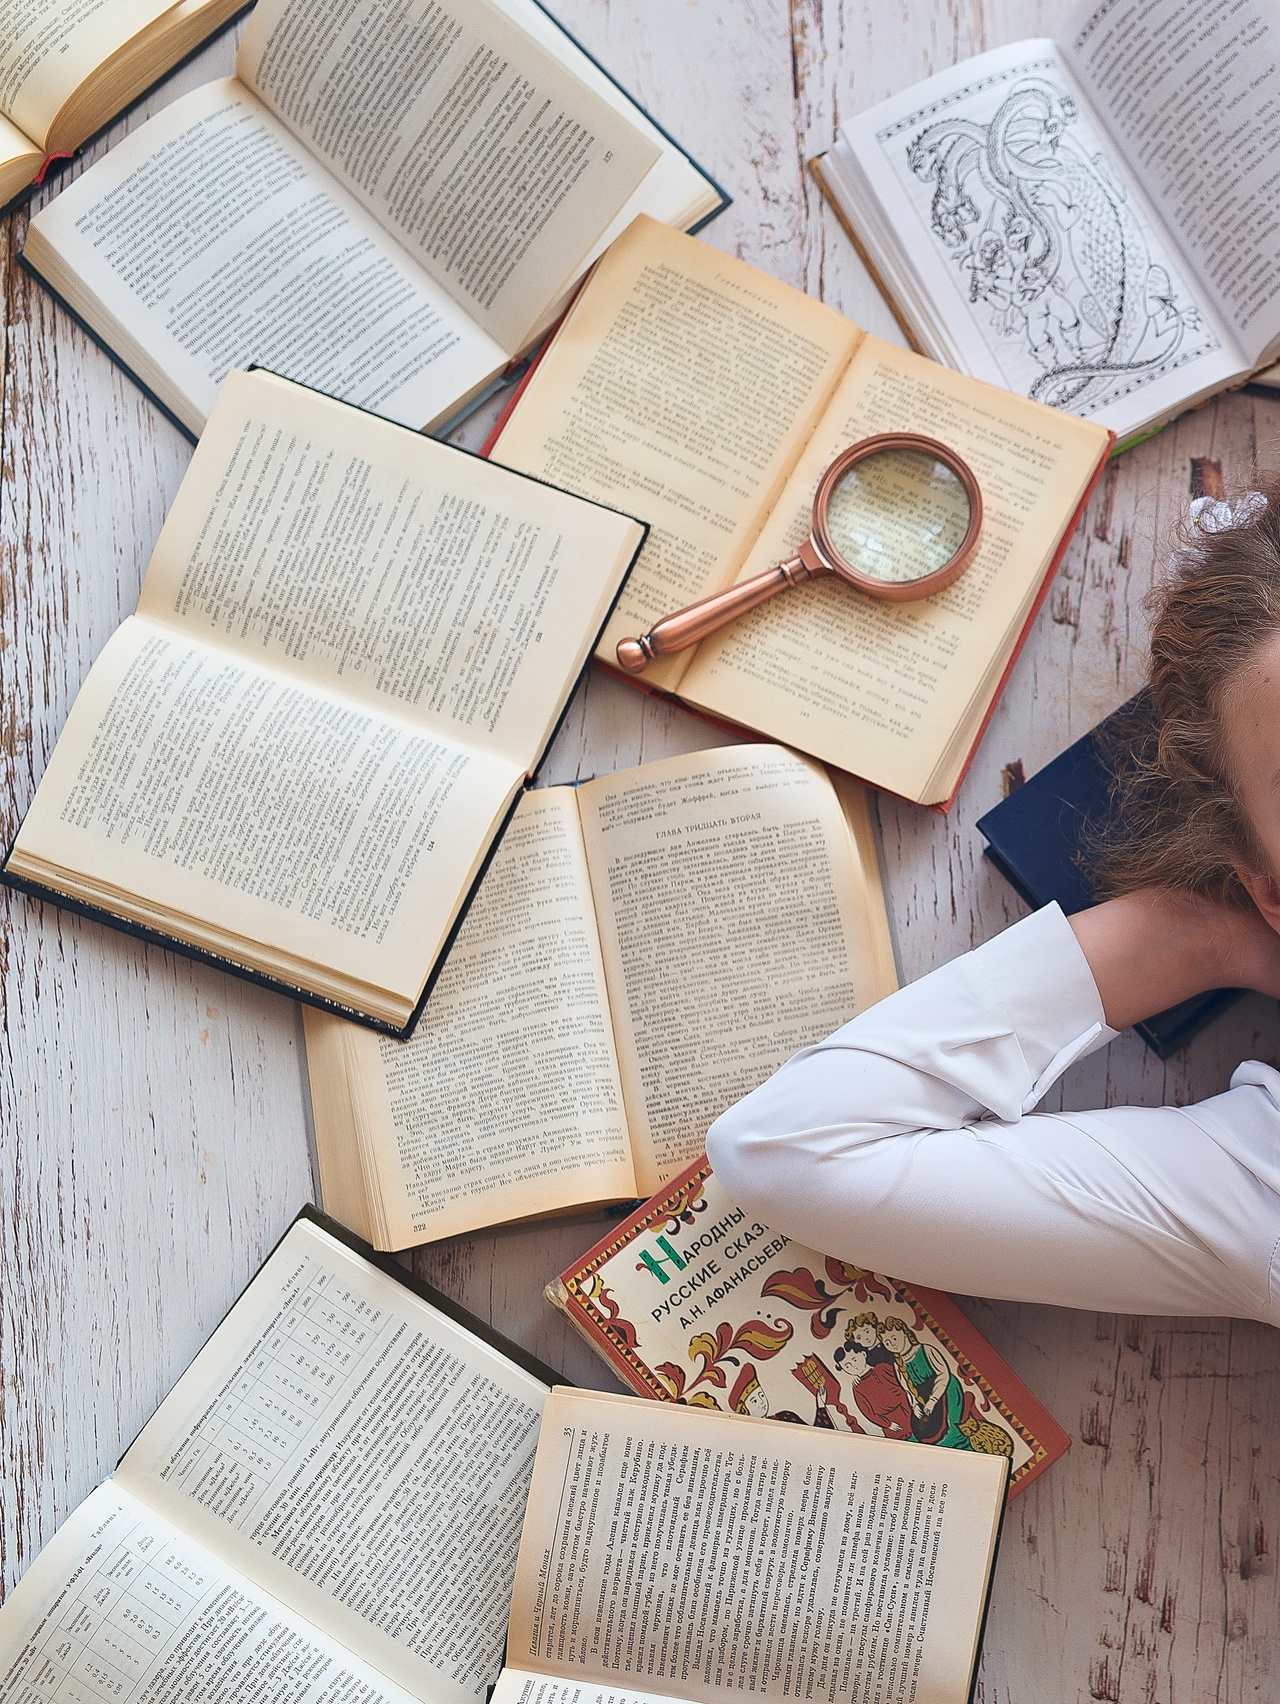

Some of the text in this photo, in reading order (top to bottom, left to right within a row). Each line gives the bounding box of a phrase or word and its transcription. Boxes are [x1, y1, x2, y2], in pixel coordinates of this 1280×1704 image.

[655, 812, 762, 839] ГЛАВА ТРИДЦАТЬ ВТОРАЯ
[426, 840, 435, 852] 124
[363, 903, 380, 932] мыслях.
[481, 1142, 505, 1154] страхе
[505, 1134, 540, 1147] подумала
[542, 1125, 580, 1138] Анжелика.
[401, 1144, 475, 1170] ла добежать до таза.
[417, 1193, 430, 1202] Но
[430, 1184, 462, 1198] внезапно
[462, 1179, 483, 1189] страх
[483, 1172, 506, 1184] сошел
[523, 1163, 541, 1173] лица
[548, 1158, 562, 1166] оно
[412, 1222, 427, 1233] 322
[638, 1206, 749, 1285] НАРОДНЫ
[281, 1263, 305, 1292] Таблица
[650, 1222, 770, 1323] РУССКИЕ СКАЗ
[679, 1233, 793, 1330] А.Н. АФАНАСЬЕВА
[248, 1520, 265, 1541] торце
[262, 1488, 290, 1522] световода,
[286, 1462, 307, 1489] равной
[307, 1443, 323, 1459] мВт,
[319, 1398, 353, 1444] внутривенное
[350, 1365, 377, 1400] облучение
[374, 1321, 408, 1367] осуществляют
[562, 1427, 572, 1437] 35
[576, 1438, 586, 1460] лица
[623, 1436, 633, 1458] юнее
[177, 1457, 195, 1477] Частота,
[192, 1448, 201, 1457] Гц
[572, 1461, 582, 1482] цвет
[619, 1461, 629, 1479] еще
[270, 1451, 339, 1540] Методика отпуска процедур.
[566, 1484, 578, 1518] свежий
[612, 1482, 625, 1517] казался
[90, 1513, 117, 1539] Таблица
[558, 1518, 571, 1560] сохраняя
[605, 1520, 618, 1551] Алеша
[556, 1431, 599, 1661] глянцевость кожи, зато потом быстро начинают жух-
[538, 1548, 551, 1580] Монах
[553, 1562, 564, 1592] сорока
[602, 1553, 612, 1575] годы
[770, 1463, 813, 1681] Чаровница смеялась, стреляла поверх веера блес-
[532, 1580, 545, 1613] Черный
[552, 1593, 559, 1605] до
[595, 1578, 608, 1624] невеликие
[549, 1605, 557, 1621] лет
[528, 1623, 539, 1656] Пелагия
[545, 1622, 556, 1659] старятся,
[577, 1635, 588, 1665] яблоко.
[592, 1626, 601, 1645] свои
[805, 1607, 825, 1700] ученому мужу голову.
